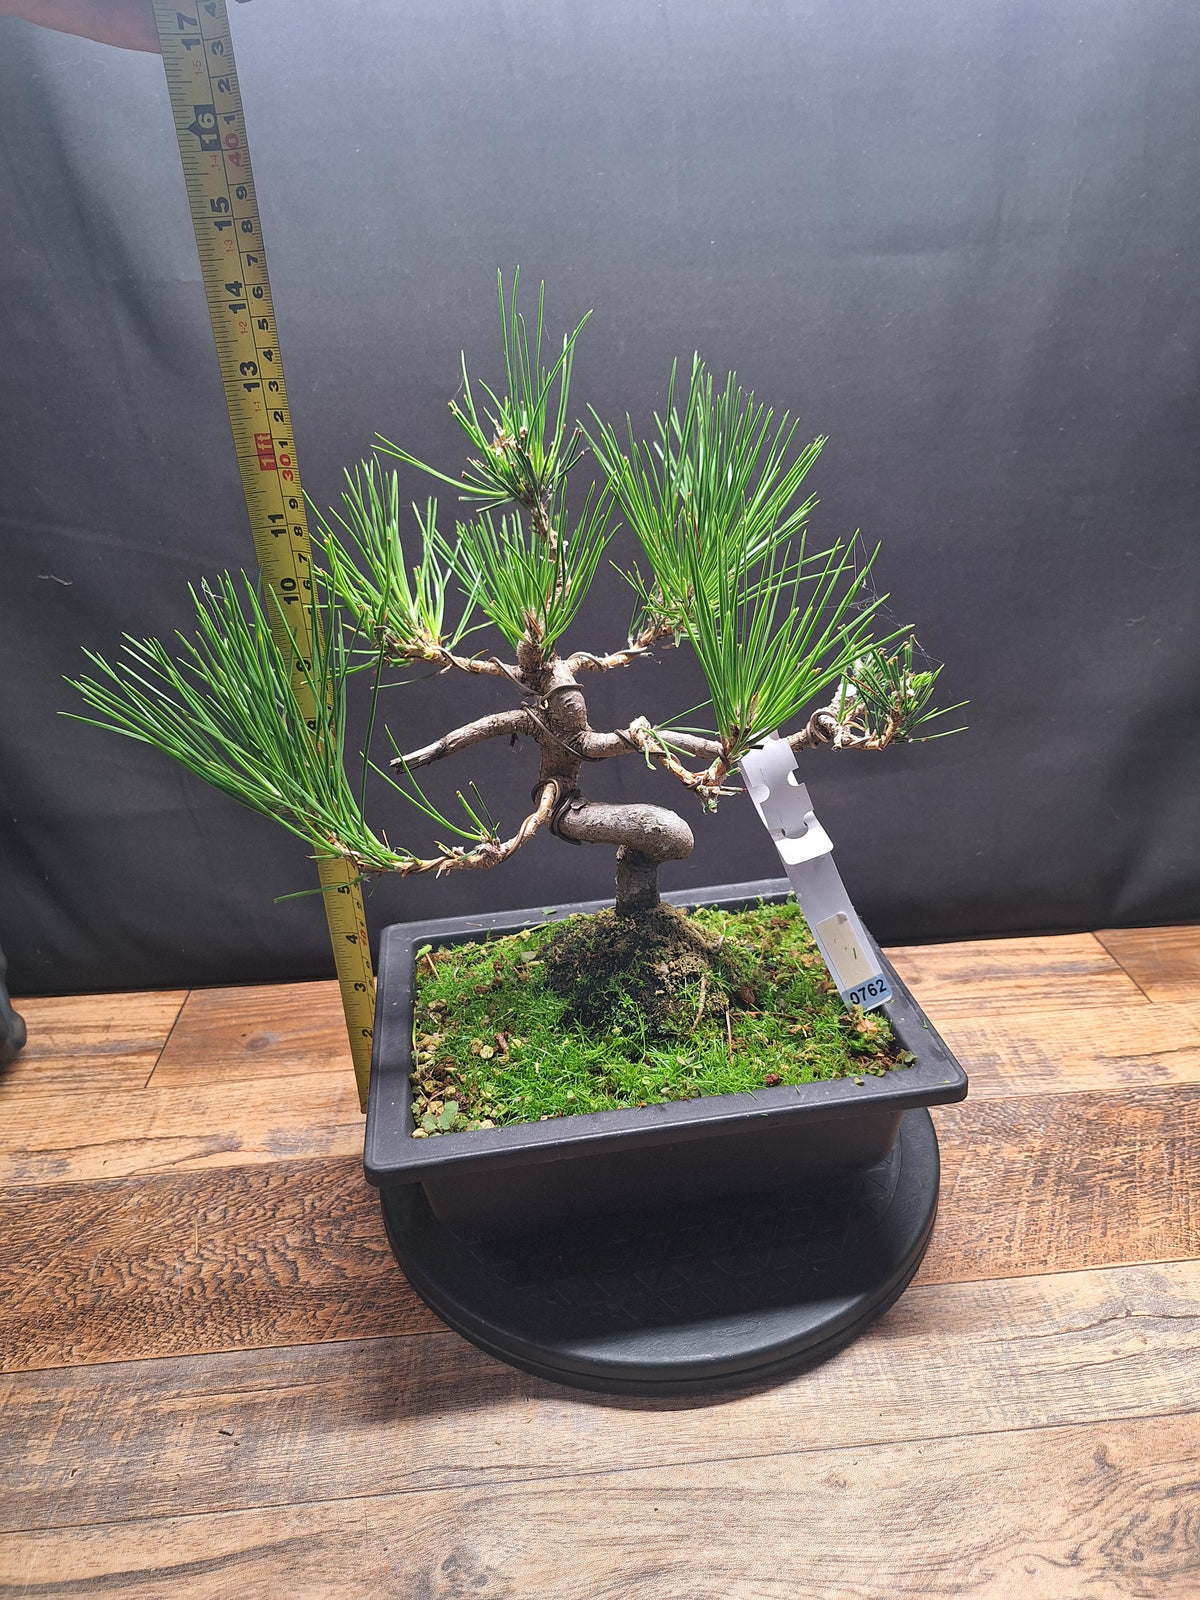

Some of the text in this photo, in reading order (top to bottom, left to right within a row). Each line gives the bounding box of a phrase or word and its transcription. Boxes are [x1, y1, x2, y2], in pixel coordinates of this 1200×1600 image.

[176, 12, 201, 51] 17
[211, 40, 224, 56] 3
[217, 77, 231, 93] 2
[223, 115, 235, 125] 1
[197, 112, 218, 144] 16
[235, 185, 248, 200] 9
[209, 196, 232, 231] 15
[241, 220, 253, 233] 8
[246, 254, 258, 266] 7
[225, 280, 246, 315] 14
[252, 285, 264, 299] 6
[257, 318, 269, 331] 5
[262, 349, 274, 362] 4
[240, 361, 260, 392] 13
[268, 380, 279, 392] 3
[273, 410, 284, 422] 2
[279, 453, 294, 482] 30
[288, 498, 299, 509] 9
[268, 514, 287, 538] 11
[294, 526, 303, 537] 8
[298, 553, 307, 563] 7
[280, 577, 299, 605] 10
[345, 934, 358, 944] 4
[354, 982, 366, 993] 3
[850, 978, 887, 1005] 0762
[361, 1028, 373, 1038] 2
